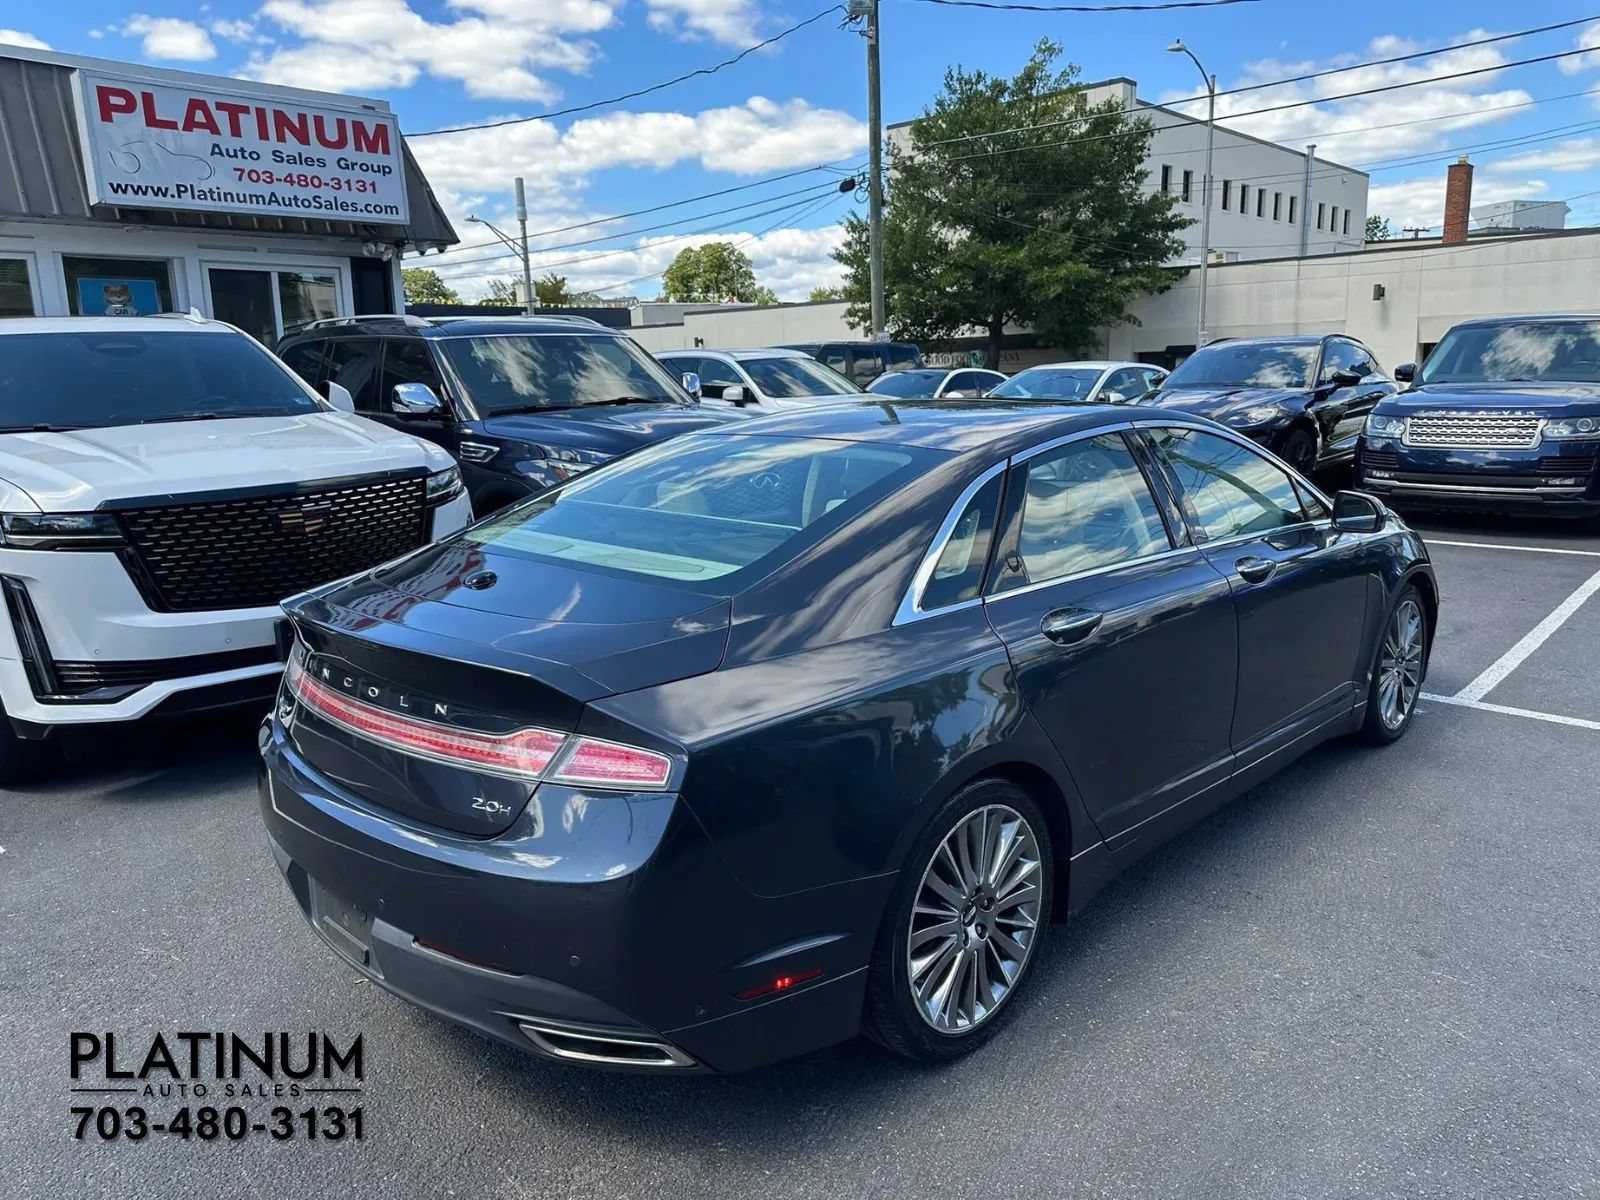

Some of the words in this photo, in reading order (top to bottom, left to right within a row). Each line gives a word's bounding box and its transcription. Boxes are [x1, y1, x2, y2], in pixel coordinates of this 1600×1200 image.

[96, 85, 390, 155] PLATINUM
[210, 143, 261, 161] Auto
[272, 149, 327, 168] Sales
[337, 157, 393, 176] Group
[233, 167, 378, 194] 703-480-3131
[108, 181, 400, 216] www.PlatinumAutoSales.com
